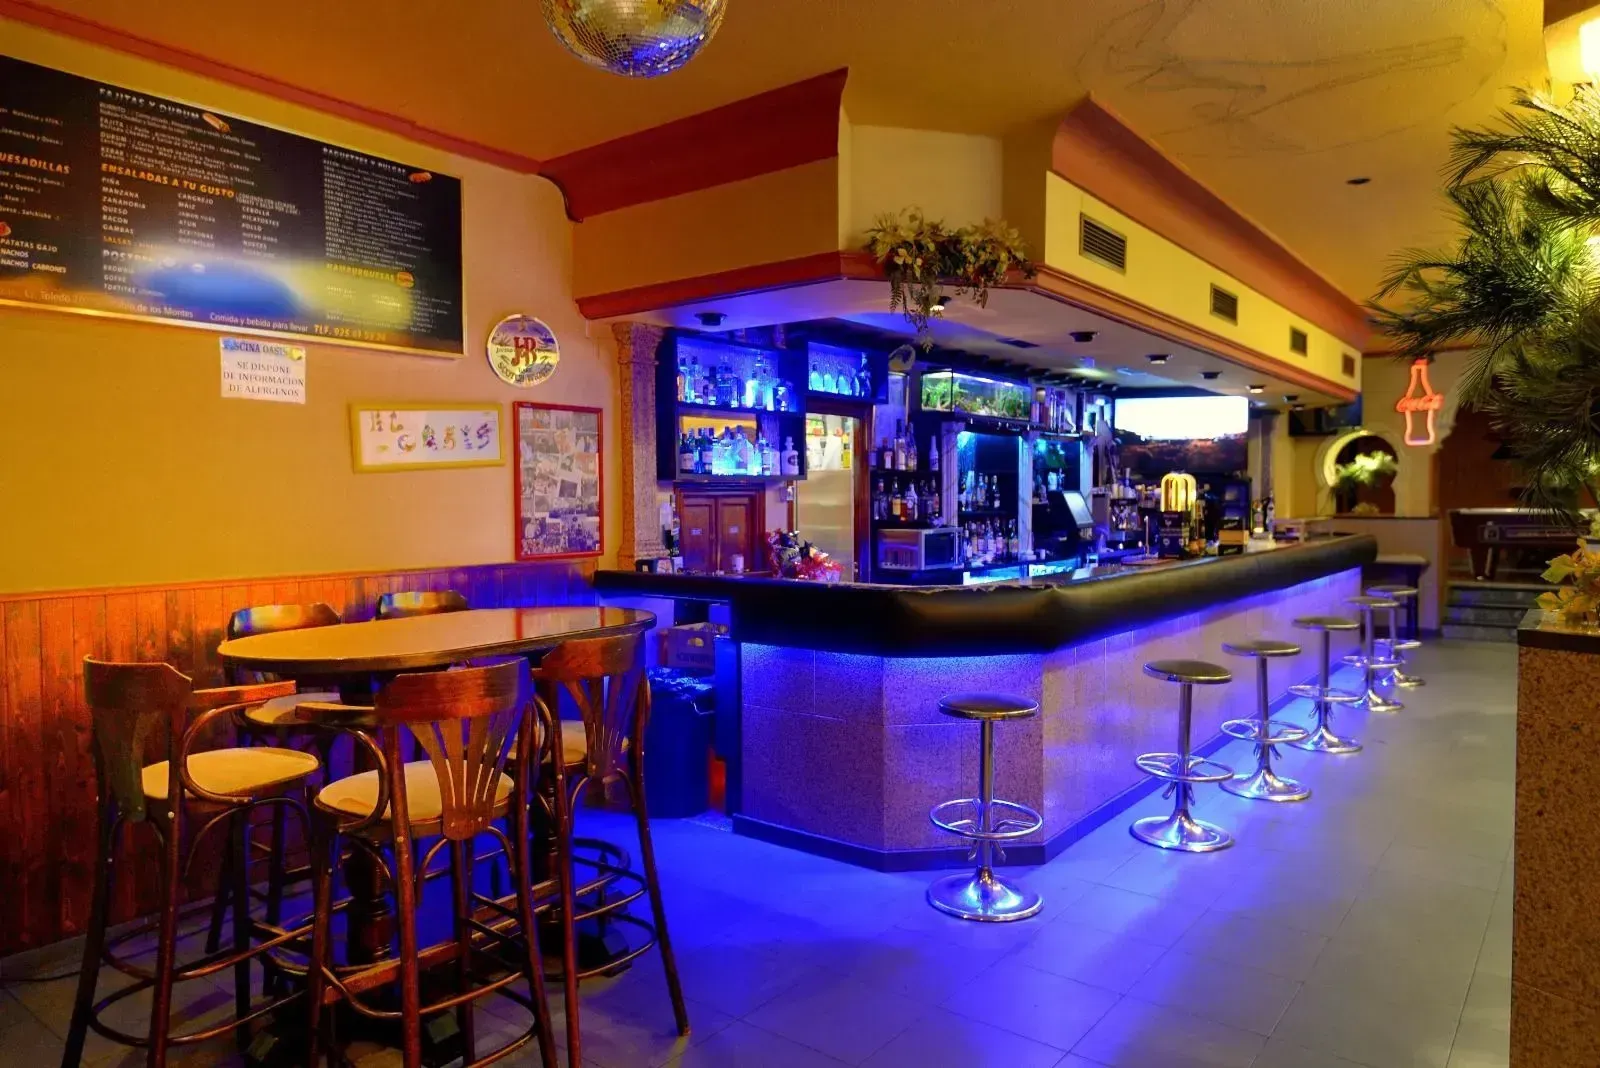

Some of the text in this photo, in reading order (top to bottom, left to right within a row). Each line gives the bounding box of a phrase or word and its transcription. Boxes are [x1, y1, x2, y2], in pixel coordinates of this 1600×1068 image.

[0, 151, 71, 174] UESADILLAS
[101, 163, 169, 185] ENSALADAS
[172, 178, 179, 187] A
[183, 180, 197, 191] TU
[200, 184, 235, 199] GUSTO
[102, 186, 139, 199] MANZANA
[102, 196, 146, 209] ZANAHORIA
[102, 205, 128, 215] QUESO
[242, 206, 270, 217] CEBOLLA
[102, 214, 129, 225] BACON
[102, 224, 134, 235] GAMBAS
[241, 222, 263, 232] POLLO
[1, 239, 58, 253] PATATAS GAJO
[1, 248, 29, 258] NACHOS
[1, 259, 67, 274] NACHOS CABRONES
[136, 302, 148, 313] de
[150, 304, 162, 315] los
[164, 306, 194, 318] Montes
[209, 311, 239, 325] Comida
[246, 317, 271, 329] bebida
[272, 321, 288, 331] para
[290, 322, 309, 333] llevar
[314, 324, 332, 335] TLF.
[237, 361, 290, 374] SE DISPONE
[223, 372, 304, 387] DE INFORMACION
[229, 384, 299, 397] DE ALERGENOS
